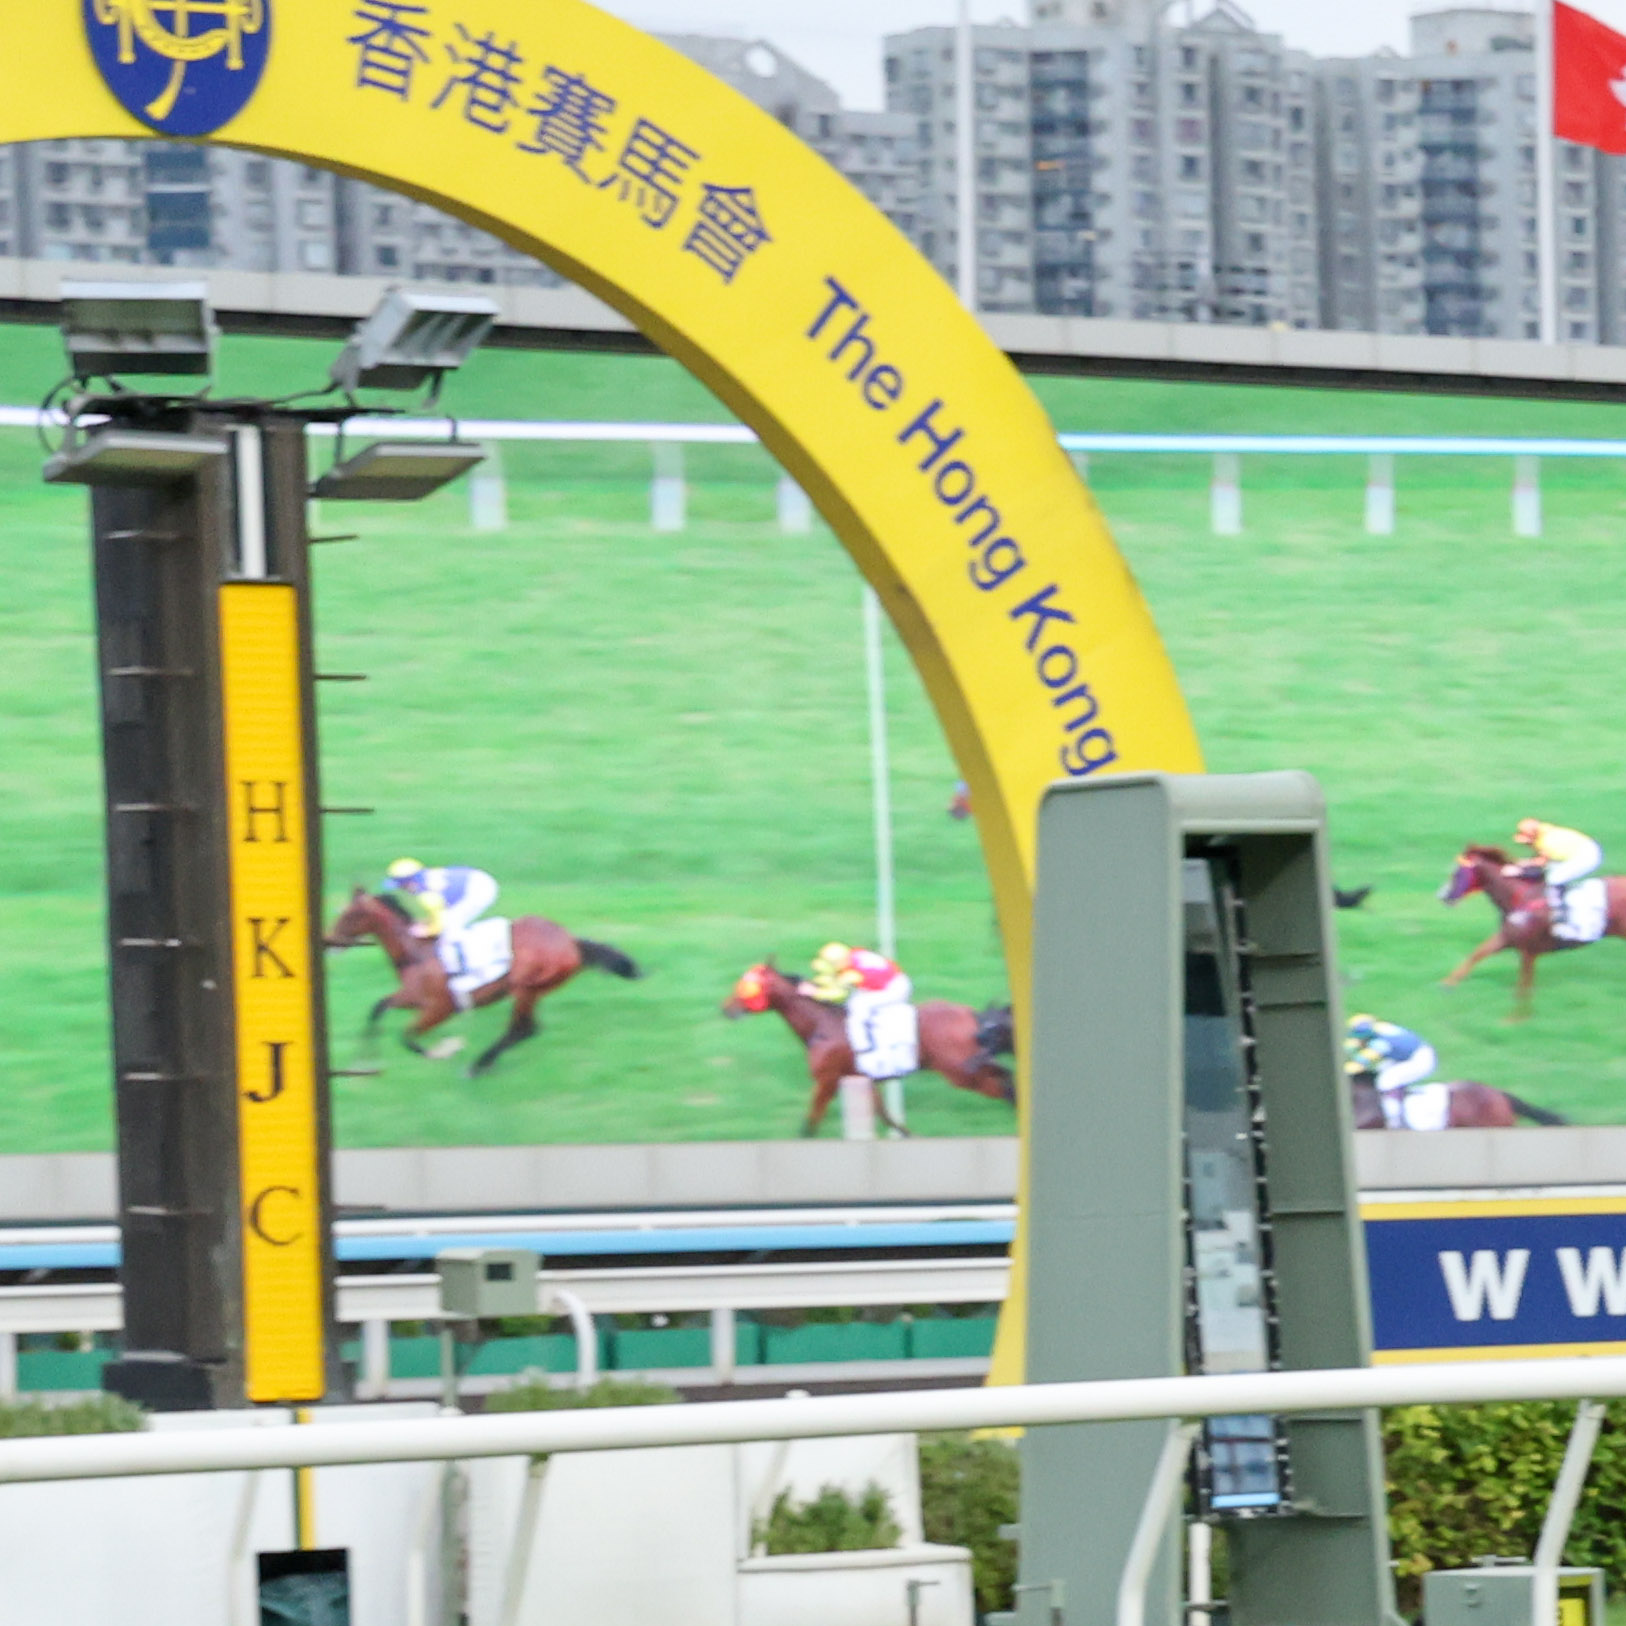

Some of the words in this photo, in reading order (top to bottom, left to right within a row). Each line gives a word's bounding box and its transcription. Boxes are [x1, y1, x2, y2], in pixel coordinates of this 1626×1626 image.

[346, 0, 773, 285] 香港賽馬會
[806, 275, 905, 411] The
[896, 398, 1028, 592] Hong
[1008, 582, 1120, 776] Kong
